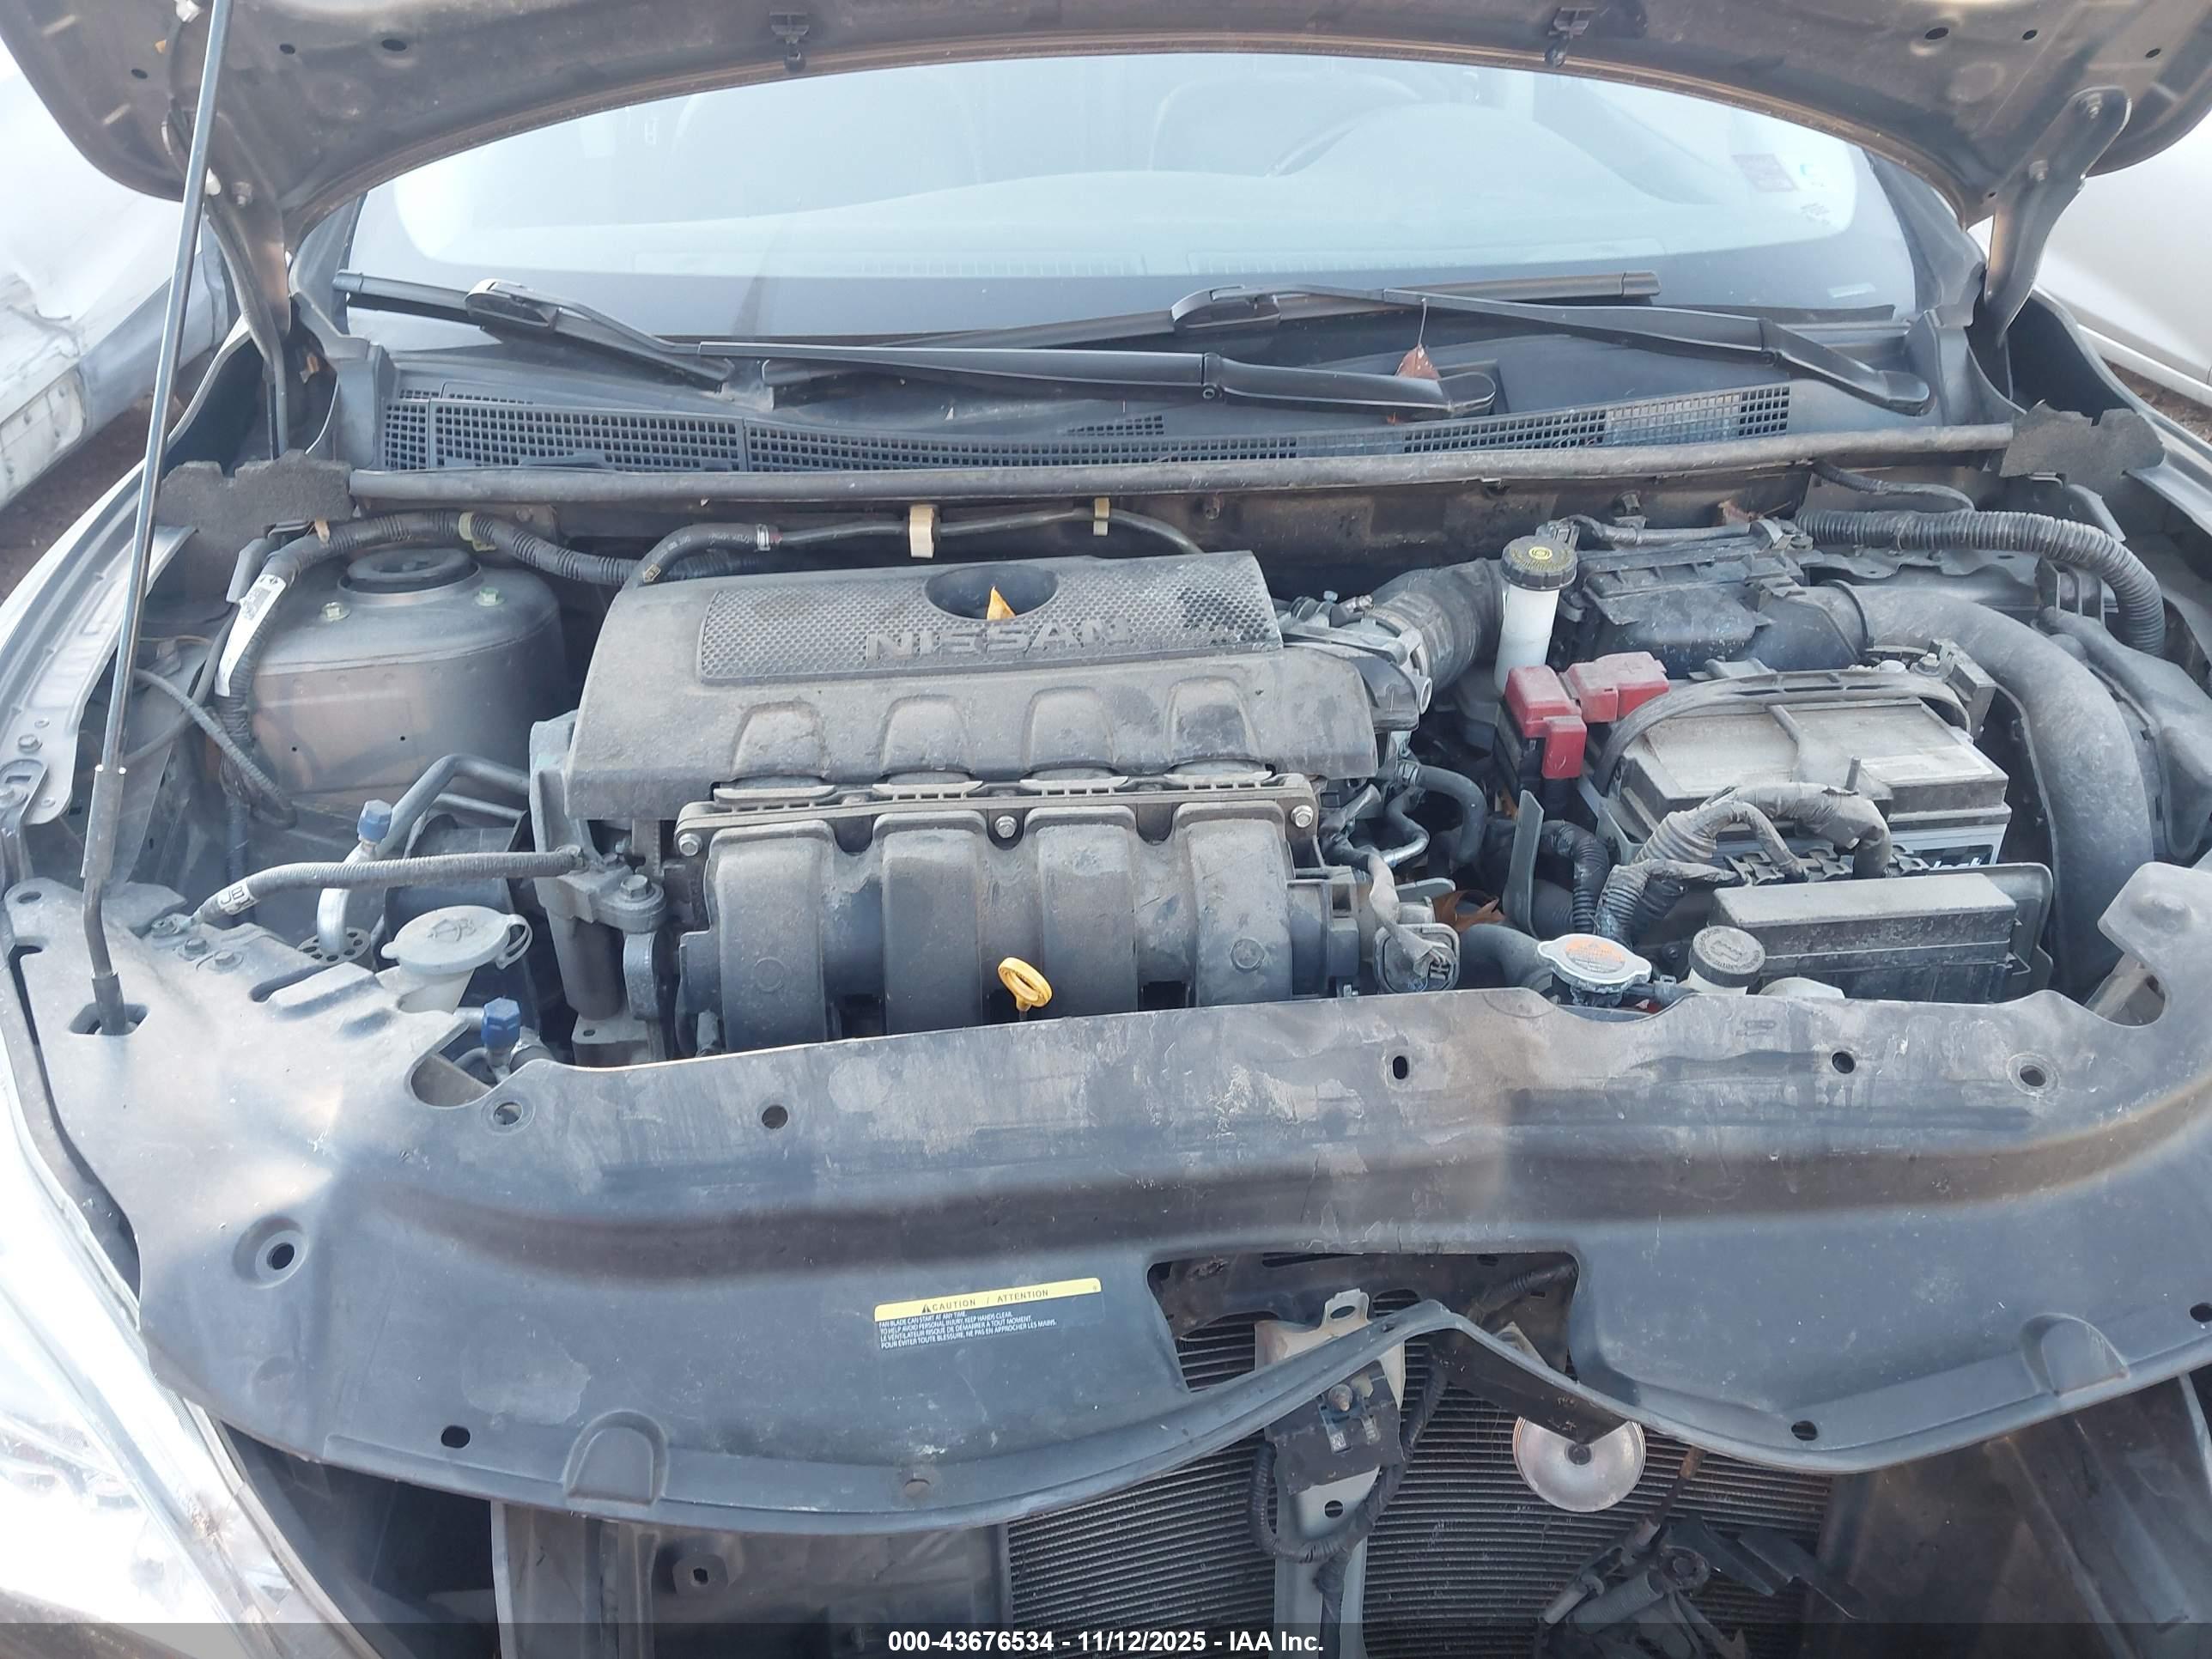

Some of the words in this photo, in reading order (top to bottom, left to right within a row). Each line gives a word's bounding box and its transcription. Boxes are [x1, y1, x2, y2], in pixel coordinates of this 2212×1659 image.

[866, 617, 1132, 659] NISSAN
[933, 1298, 975, 1312] CAUTION
[997, 1289, 1048, 1303] ATTENTION
[887, 1329, 925, 1341] VENTILATEUR
[926, 1327, 945, 1335] RISQUE
[991, 1319, 1006, 1328] TOUT
[919, 1315, 934, 1323] START
[919, 1321, 945, 1330] PERSONAL
[977, 1313, 995, 1322] HANDS
[881, 1340, 897, 1349] POUR
[917, 1336, 936, 1345] TOUTE
[975, 1328, 985, 1337] PAS
[994, 1323, 1027, 1334] APPROCHER
[1028, 1321, 1037, 1329] LES
